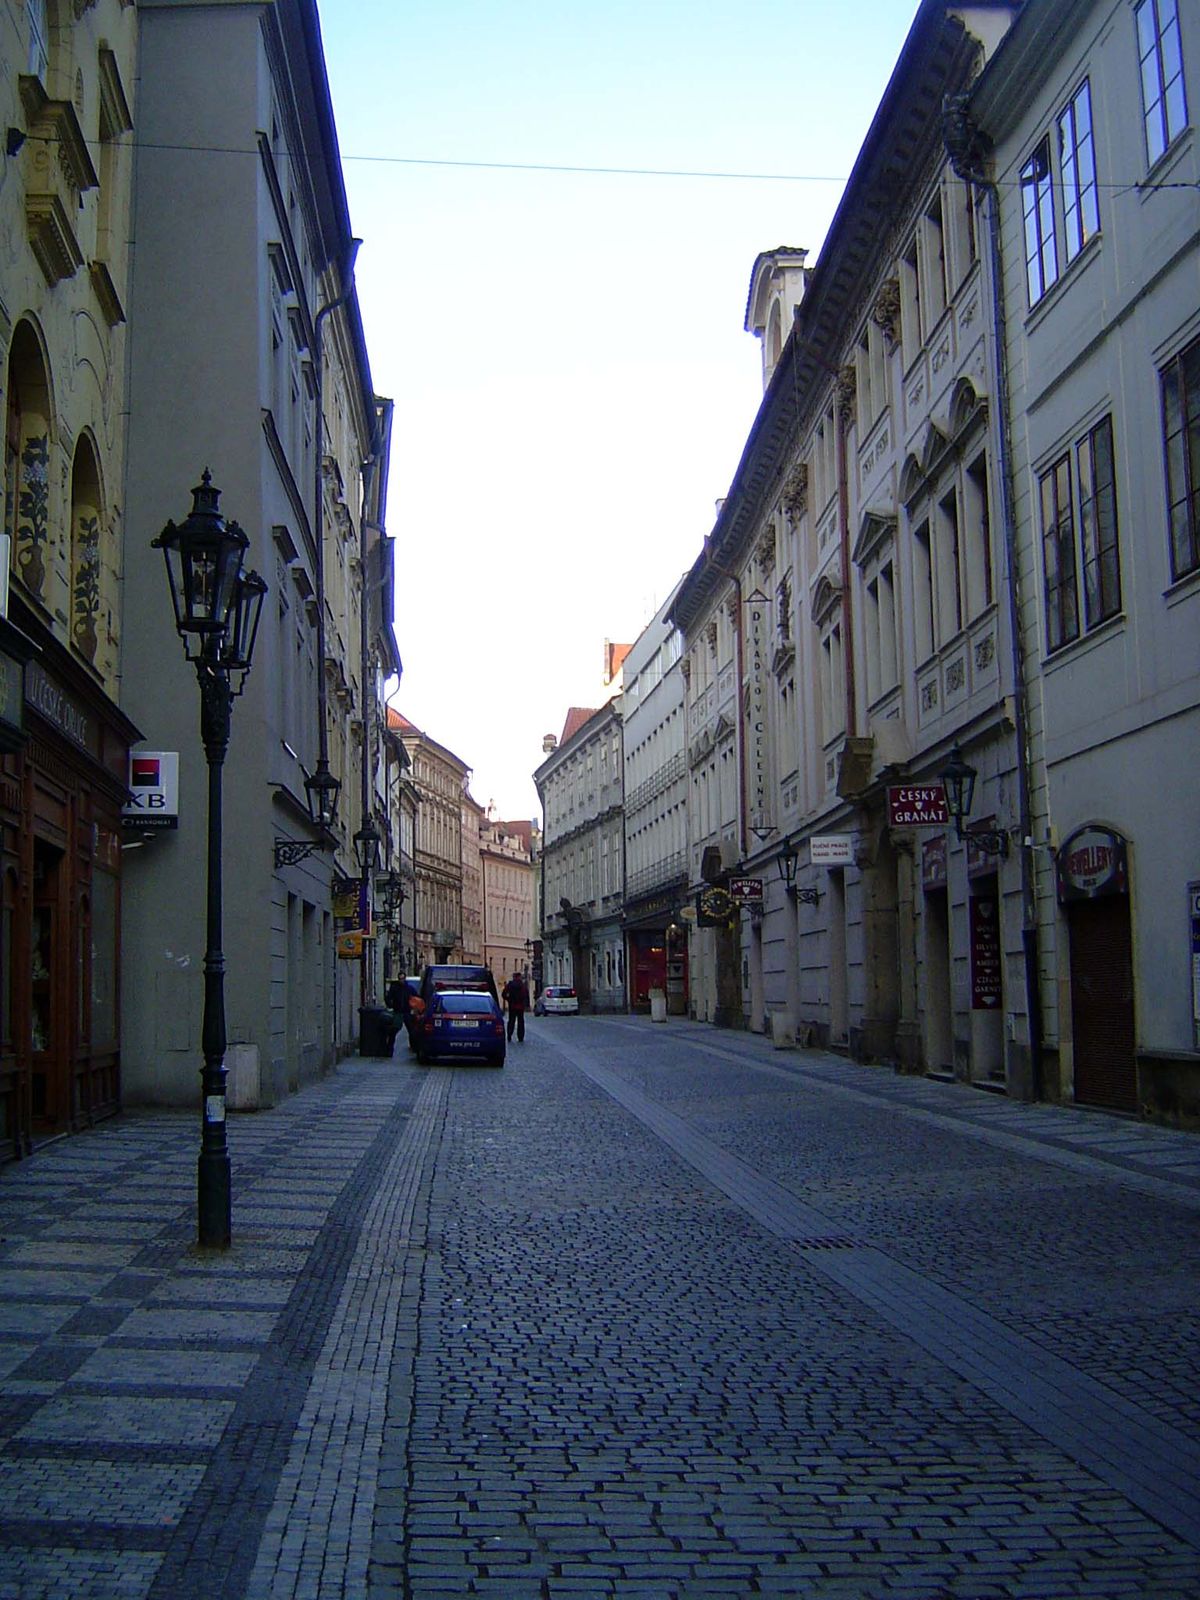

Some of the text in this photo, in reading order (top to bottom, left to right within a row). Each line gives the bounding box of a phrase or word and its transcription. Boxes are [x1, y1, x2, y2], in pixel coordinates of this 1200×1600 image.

[752, 610, 761, 696] DIVADLO
[755, 704, 761, 713] V
[125, 793, 166, 808] KB
[898, 788, 937, 802] ČESKÝ
[895, 808, 945, 823] GRANÁT
